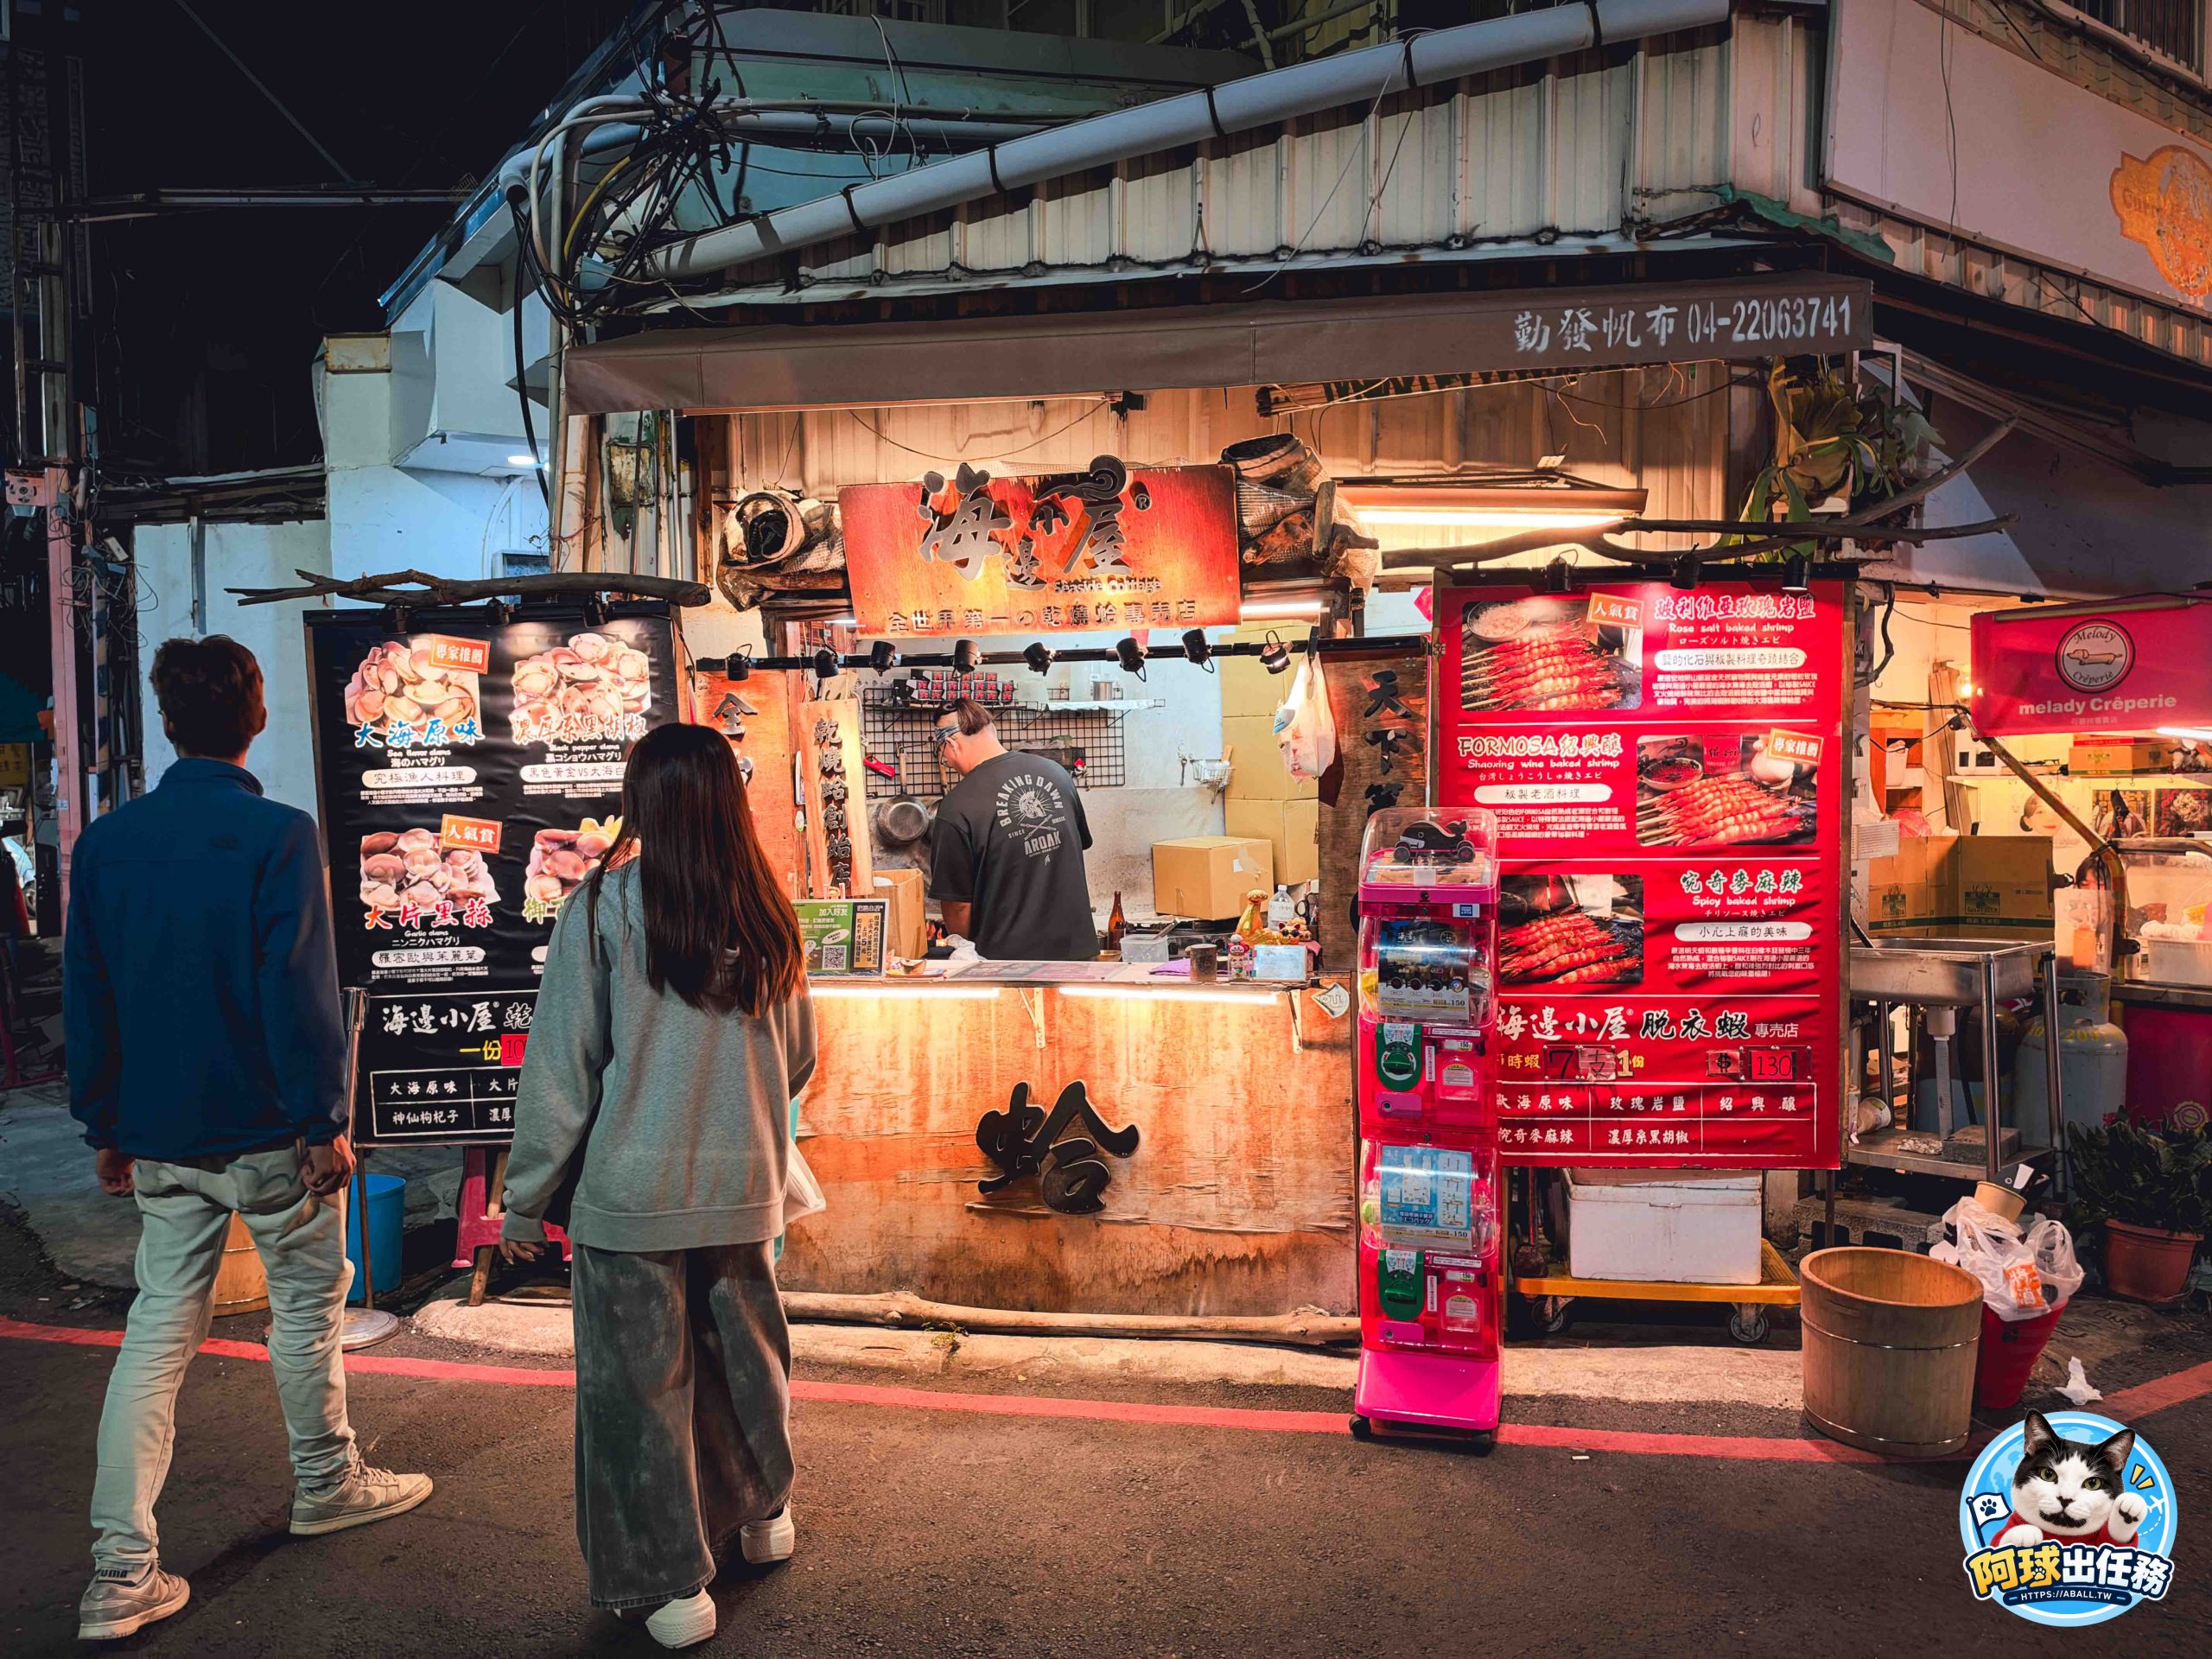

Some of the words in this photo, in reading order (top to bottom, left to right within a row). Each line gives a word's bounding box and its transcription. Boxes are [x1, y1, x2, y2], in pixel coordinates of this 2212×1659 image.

[1514, 302, 1679, 353] 勤發帆布
[1687, 295, 1850, 344] 04-22063741
[1053, 577, 1104, 594] Seaside
[1593, 601, 1639, 621] 人氣賞
[1654, 594, 1816, 620] 玻利維亞玫瑰岩鹽
[1669, 623, 1694, 632] Rose
[1700, 623, 1719, 632] salt
[1726, 623, 1757, 632] baked
[1762, 623, 1794, 633] shrimp
[2075, 628, 2116, 644] Melody
[2089, 695, 2177, 713] Crêperie
[354, 717, 486, 748] 大海原味
[512, 712, 650, 745] 濃厚系黑胡椒
[1468, 759, 1514, 770] Shaoxing
[1521, 760, 1544, 768] wine
[1550, 759, 1581, 767] baked
[1586, 758, 1620, 769] shrimp
[995, 774, 1033, 828] BREAKING
[1035, 775, 1064, 809] DAWN
[448, 827, 497, 845] 人氣賞
[1007, 829, 1026, 839] SINCE
[1692, 895, 1721, 907] Spicy
[1726, 896, 1758, 906] baked
[1763, 896, 1796, 907] shrimp
[365, 899, 493, 930] 大片黑蒜
[391, 937, 460, 947] ニンニクハマグリ
[382, 1001, 497, 1035] 海邊小屋
[1497, 1005, 1631, 1041] 海邊小屋
[1640, 1008, 1751, 1041] 脫衣蝦
[459, 1039, 502, 1061] 一份
[1497, 1053, 1541, 1069] 時蝦
[1548, 1049, 1574, 1079] 7
[1757, 1055, 1792, 1077] 130
[390, 1080, 458, 1096] 大海原味
[1610, 1096, 1686, 1111] 玫瑰岩鹽
[392, 1109, 459, 1125] 神仙枸杞子
[489, 1107, 512, 1122] 濃厚
